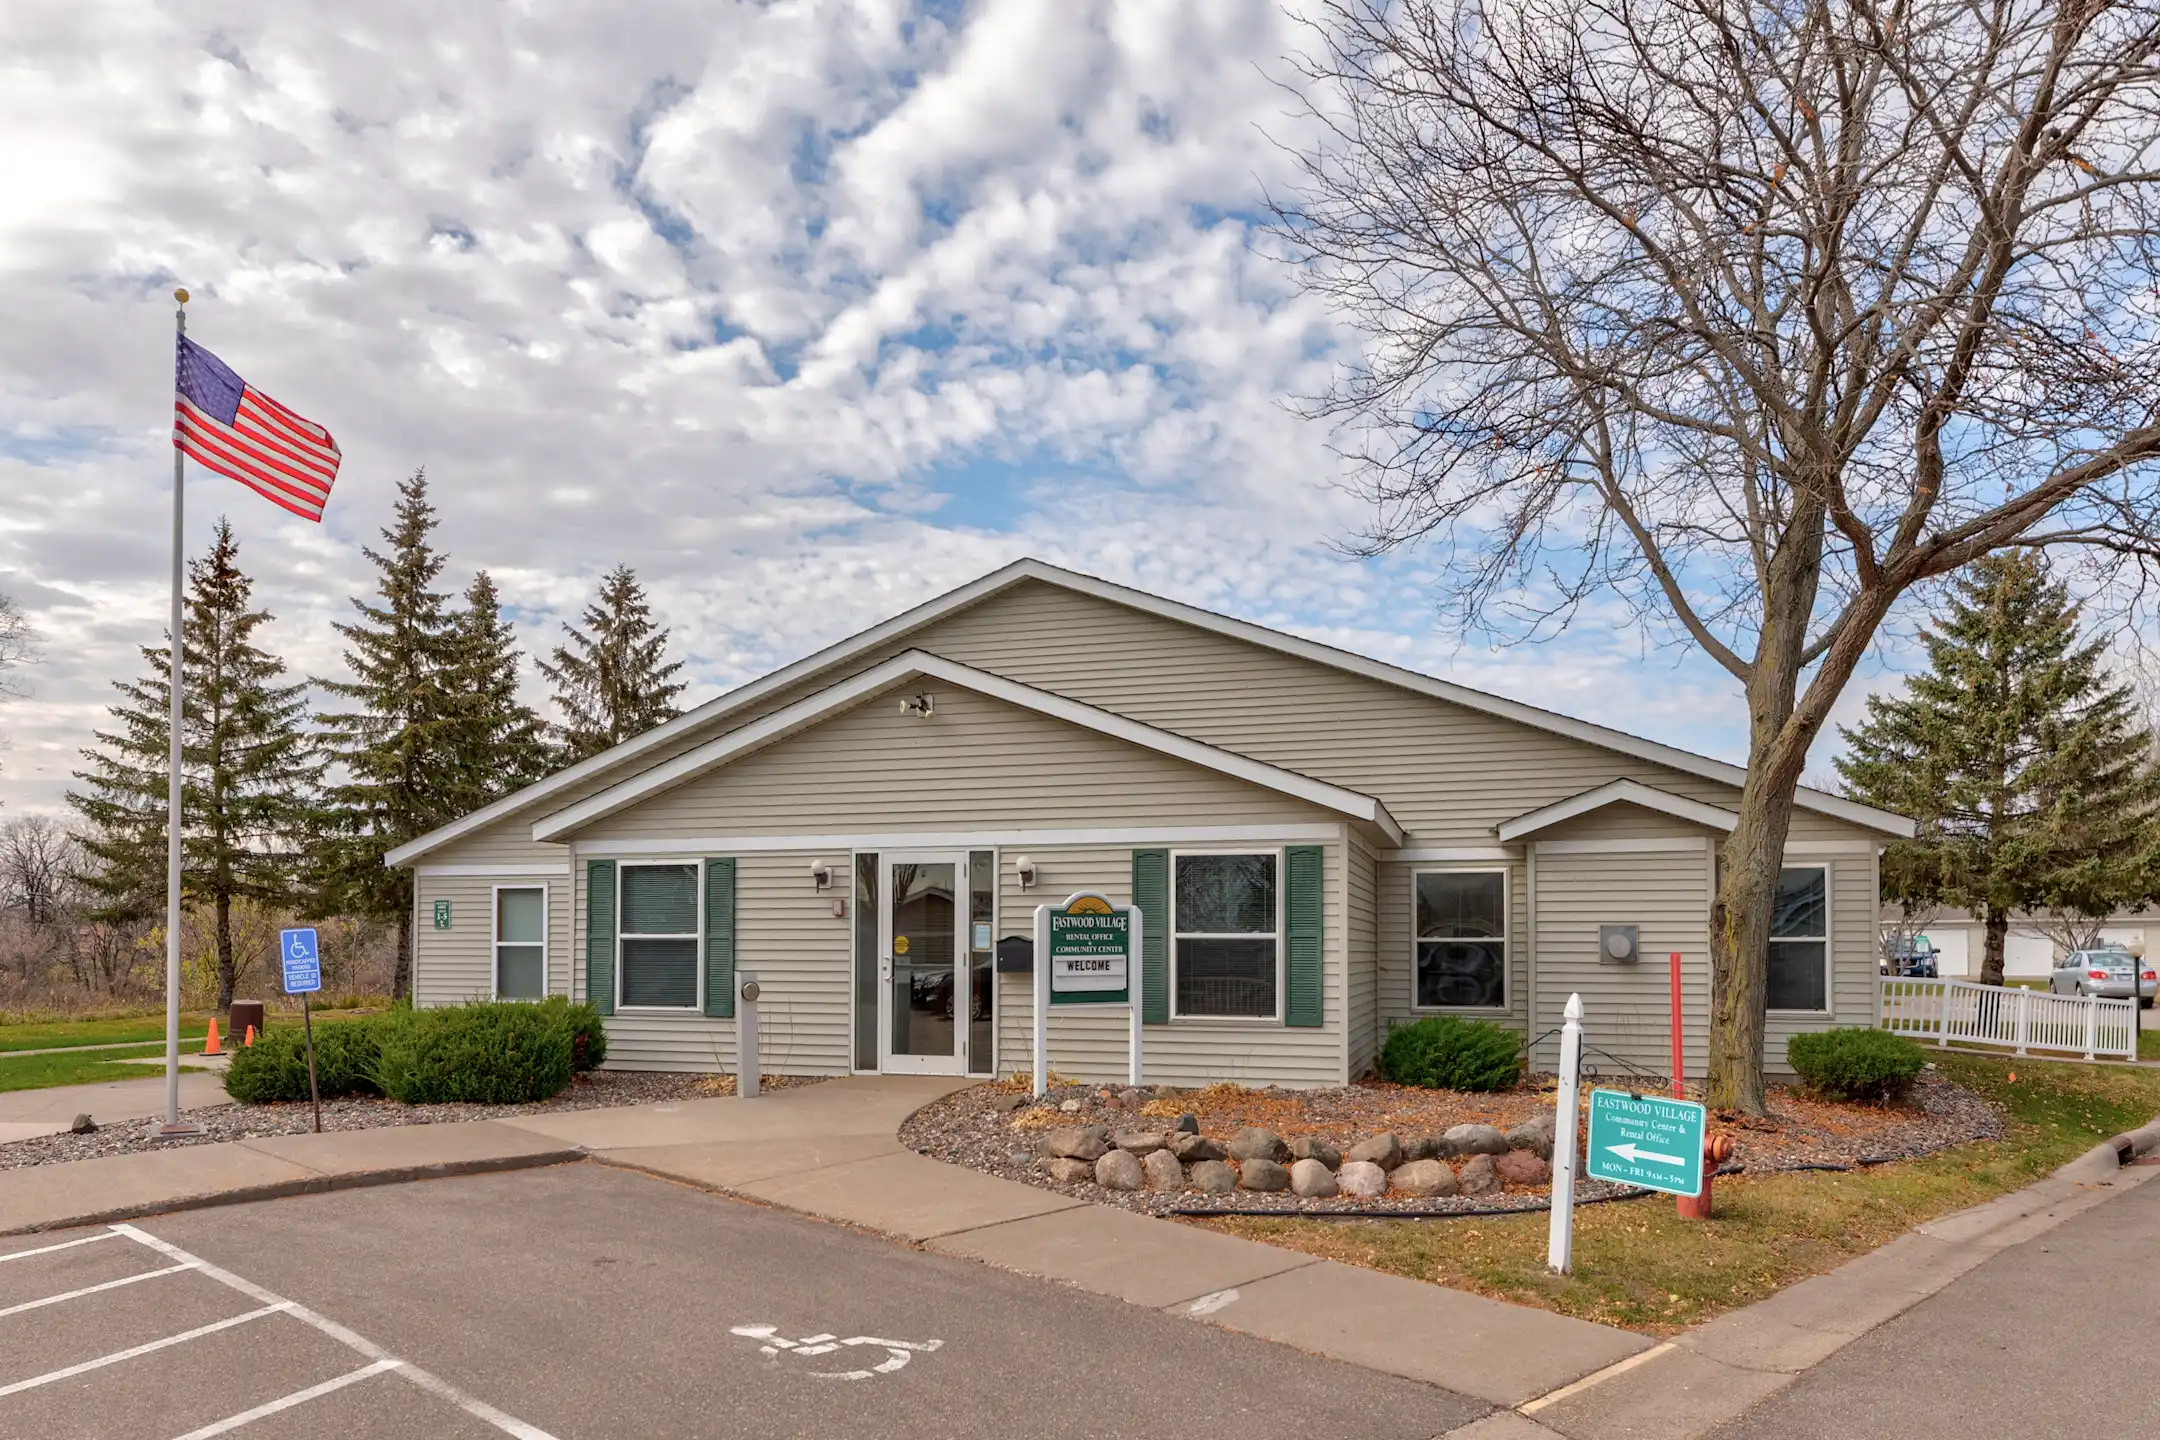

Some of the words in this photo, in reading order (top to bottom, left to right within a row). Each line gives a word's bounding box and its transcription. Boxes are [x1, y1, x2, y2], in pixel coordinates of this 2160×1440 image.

[1053, 916, 1094, 931] EASTWOOD
[1095, 916, 1127, 931] VILLAGE
[1066, 933, 1090, 941] RENTAL
[1067, 960, 1110, 971] WELCOME
[290, 979, 316, 987] REQUIRED
[1597, 1097, 1651, 1115] EASTWOOD
[1655, 1105, 1697, 1123] VILLAGE
[1605, 1112, 1649, 1128] Community
[1651, 1120, 1677, 1133] Center
[1678, 1125, 1686, 1134] &
[1620, 1127, 1644, 1140] Rental
[1646, 1131, 1670, 1145] Office
[1602, 1161, 1622, 1172] MON
[1629, 1167, 1644, 1177] FRI
